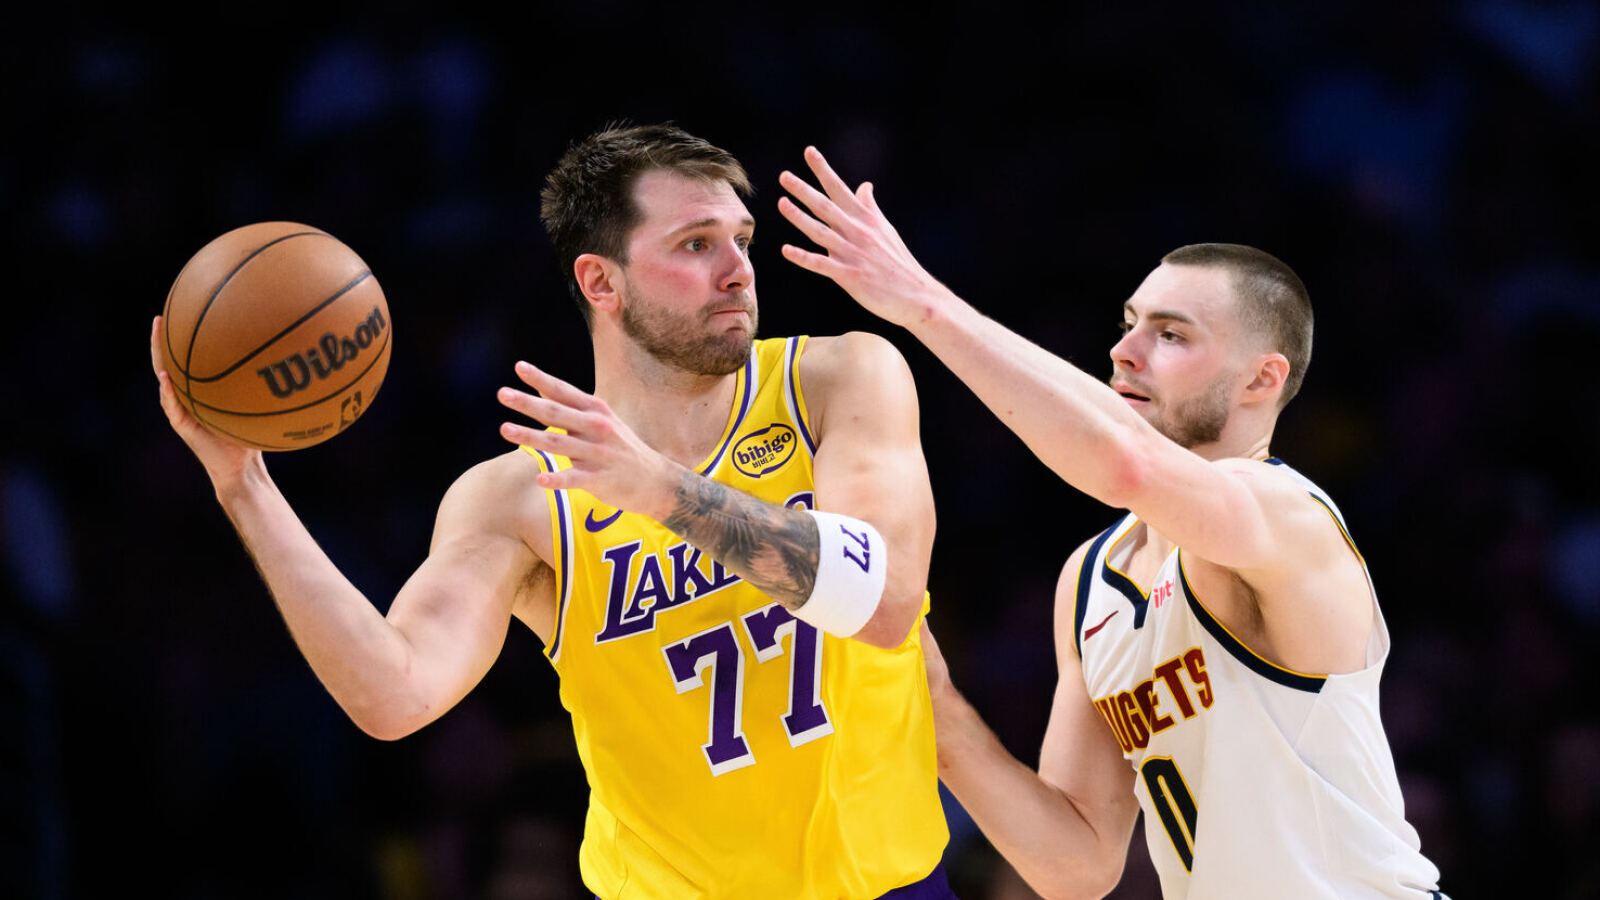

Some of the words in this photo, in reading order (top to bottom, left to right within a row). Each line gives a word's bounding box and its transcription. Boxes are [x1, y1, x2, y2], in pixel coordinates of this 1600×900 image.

[257, 306, 386, 398] Wilson
[736, 432, 792, 465] bibigo
[839, 523, 870, 573] 77
[660, 601, 835, 777] 77
[1093, 645, 1214, 754] UGETS
[1140, 755, 1198, 874] 0
